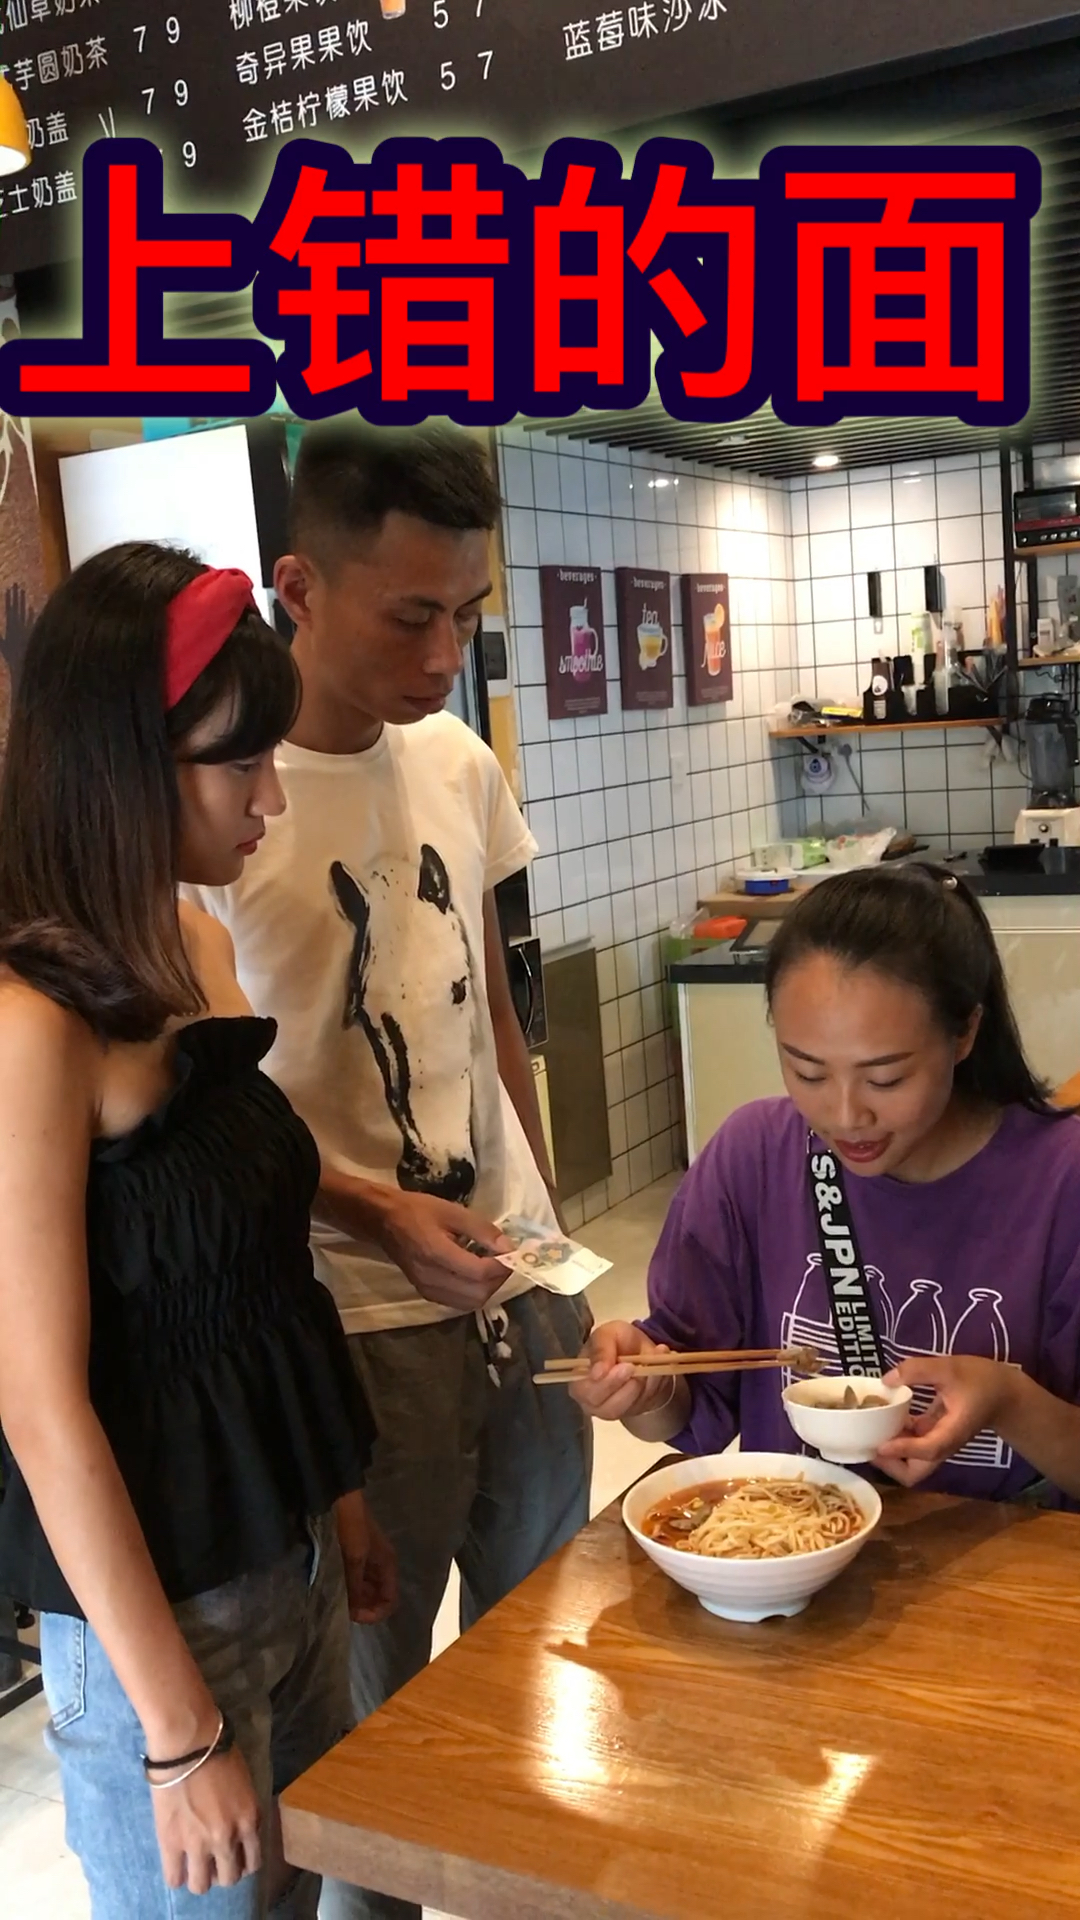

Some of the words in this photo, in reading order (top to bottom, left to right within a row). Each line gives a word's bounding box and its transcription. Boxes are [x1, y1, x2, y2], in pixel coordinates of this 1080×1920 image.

[0, 35, 109, 91] 芋圆奶茶
[133, 26, 147, 53] 7
[166, 16, 181, 44] 9
[235, 19, 373, 85] 奇异果果饮
[141, 88, 155, 115] 7
[174, 79, 189, 107] 9
[242, 69, 409, 143] 金桔柠檬果饮
[440, 61, 457, 91] 5
[477, 50, 494, 80] 7
[182, 141, 197, 168] 9
[811, 1154, 865, 1297] S&JPN
